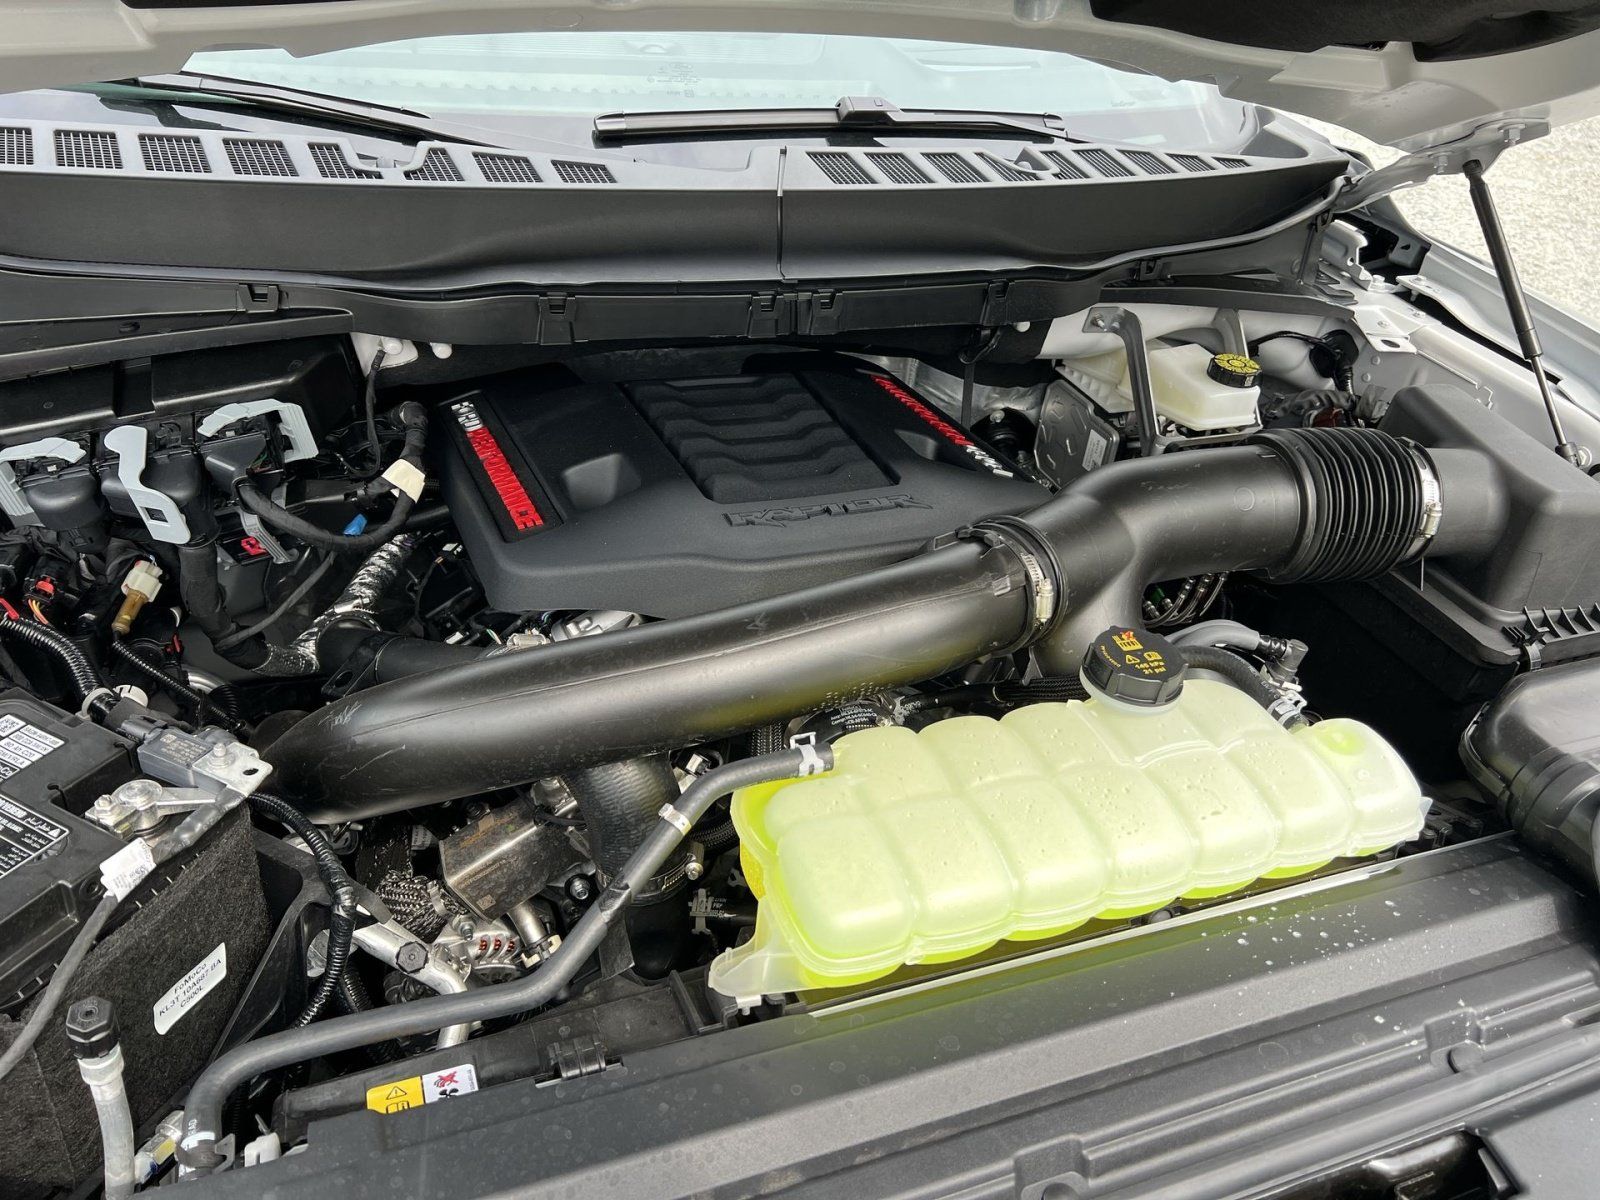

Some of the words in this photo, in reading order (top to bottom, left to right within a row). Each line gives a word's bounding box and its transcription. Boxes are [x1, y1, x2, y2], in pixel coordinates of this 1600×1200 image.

[451, 401, 483, 432] FORD
[467, 427, 544, 530] PERFORMANCE
[721, 493, 934, 528] RAPTOR
[174, 963, 206, 994] FoMoCo
[159, 994, 180, 1017] KL3T
